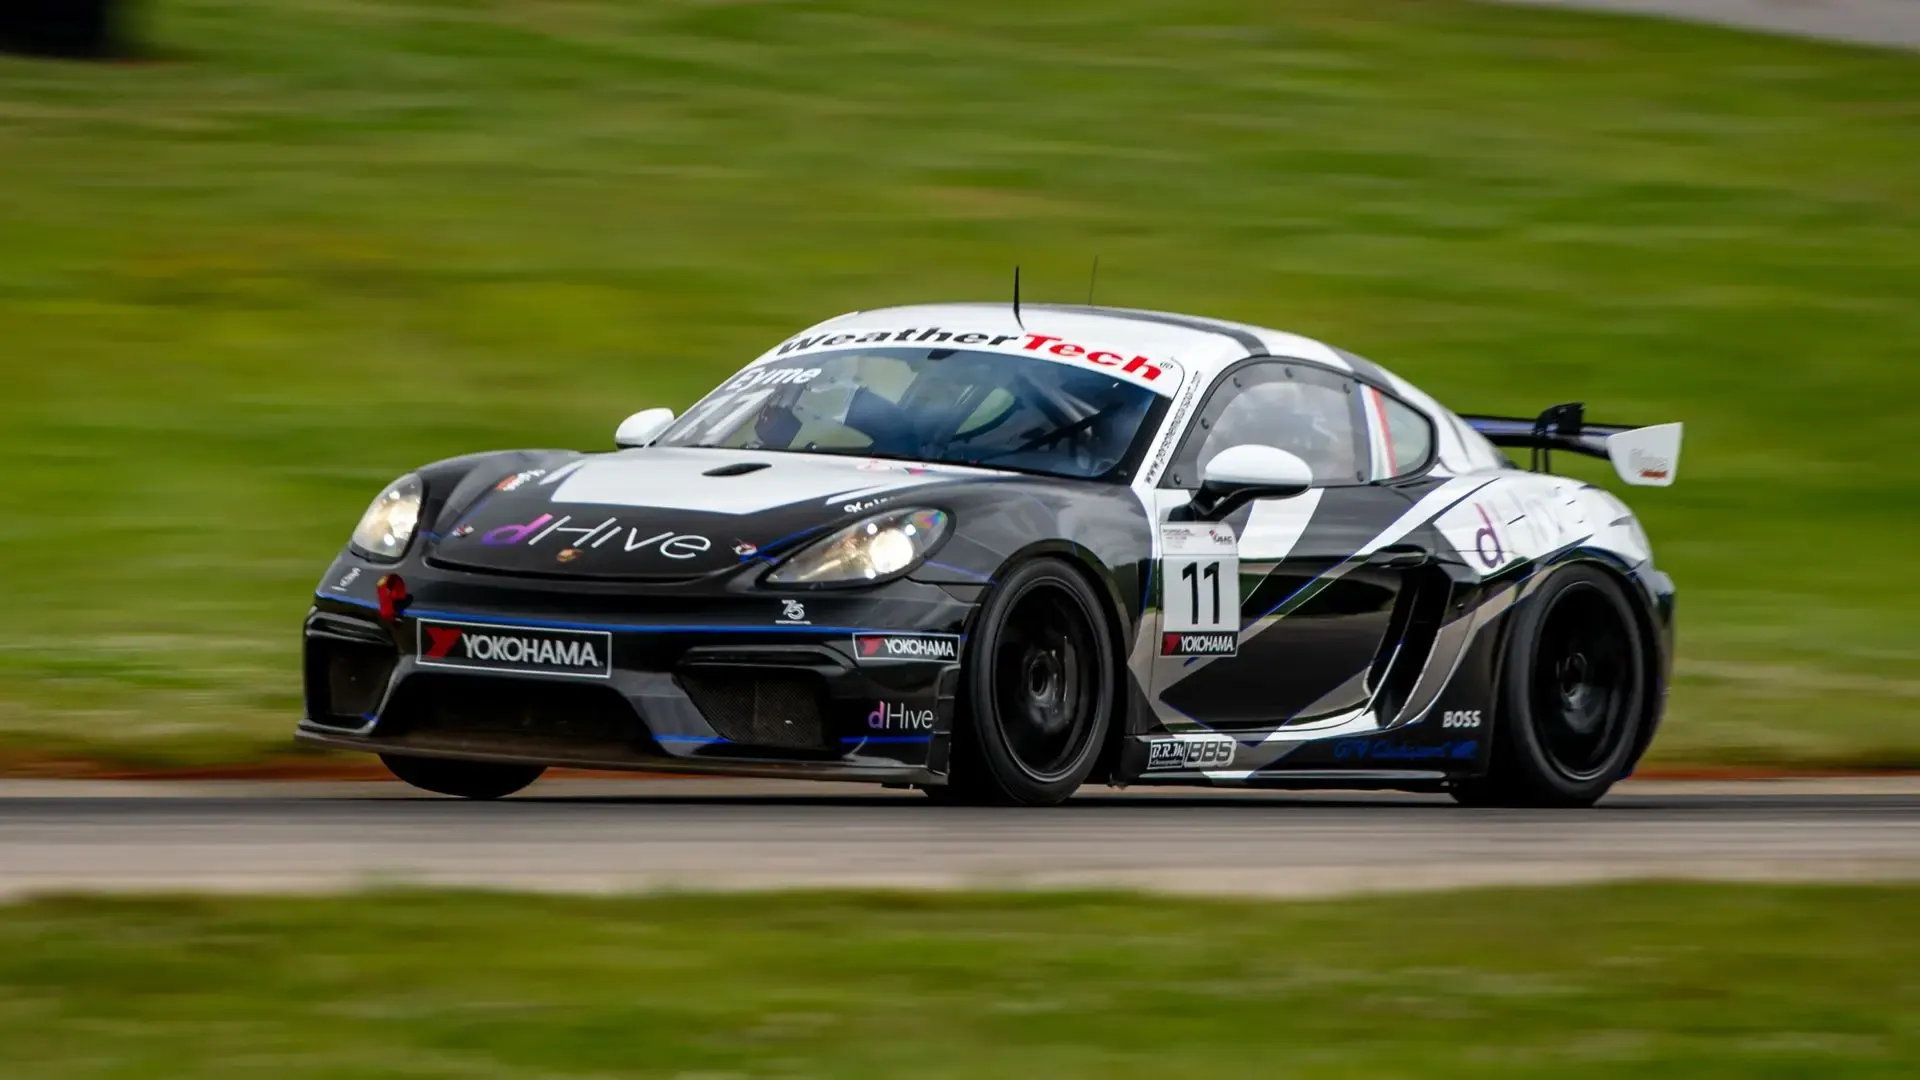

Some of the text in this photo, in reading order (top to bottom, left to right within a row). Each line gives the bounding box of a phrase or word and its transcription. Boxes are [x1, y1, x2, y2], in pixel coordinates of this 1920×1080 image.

[776, 326, 1162, 382] WeatherTech
[724, 365, 823, 392] Eyme
[481, 512, 712, 559] dHive
[1182, 561, 1220, 625] 11
[461, 632, 600, 668] YOKOHAMA
[884, 638, 955, 657] YOKOHAMA
[1180, 635, 1235, 652] YOKOHAMA
[867, 700, 934, 729] dHive
[1442, 710, 1482, 728] BOSS
